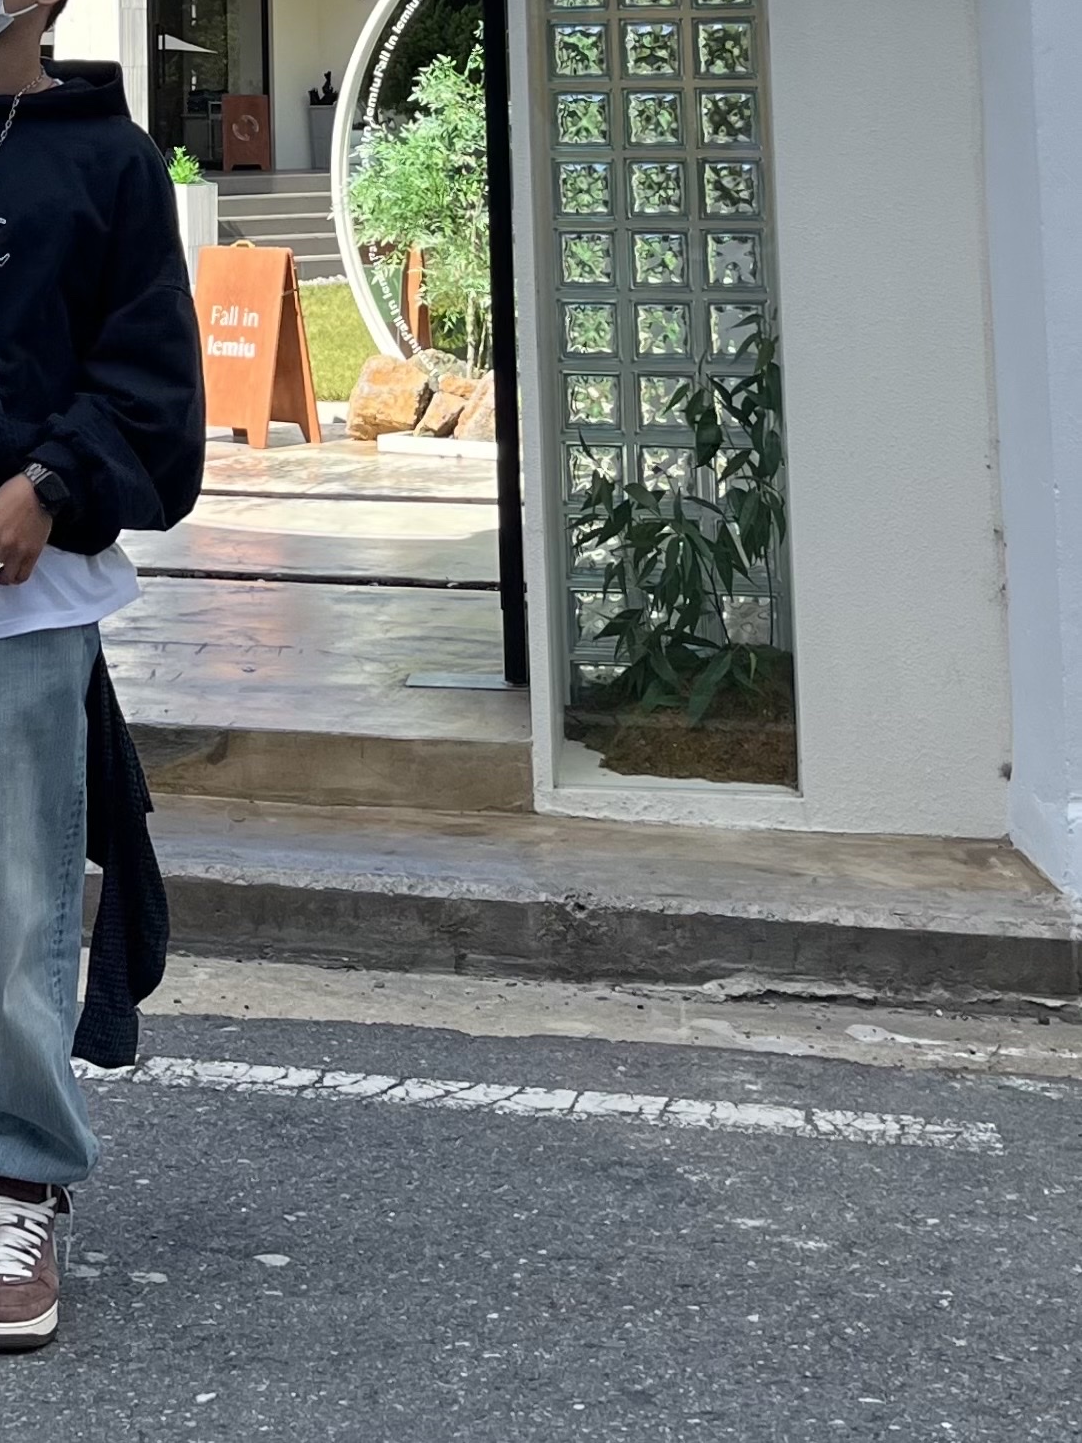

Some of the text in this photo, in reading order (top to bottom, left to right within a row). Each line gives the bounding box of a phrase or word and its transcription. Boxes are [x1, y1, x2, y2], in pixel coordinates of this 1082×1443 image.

[210, 305, 260, 328] Fall in
[207, 334, 256, 358] lemiu
